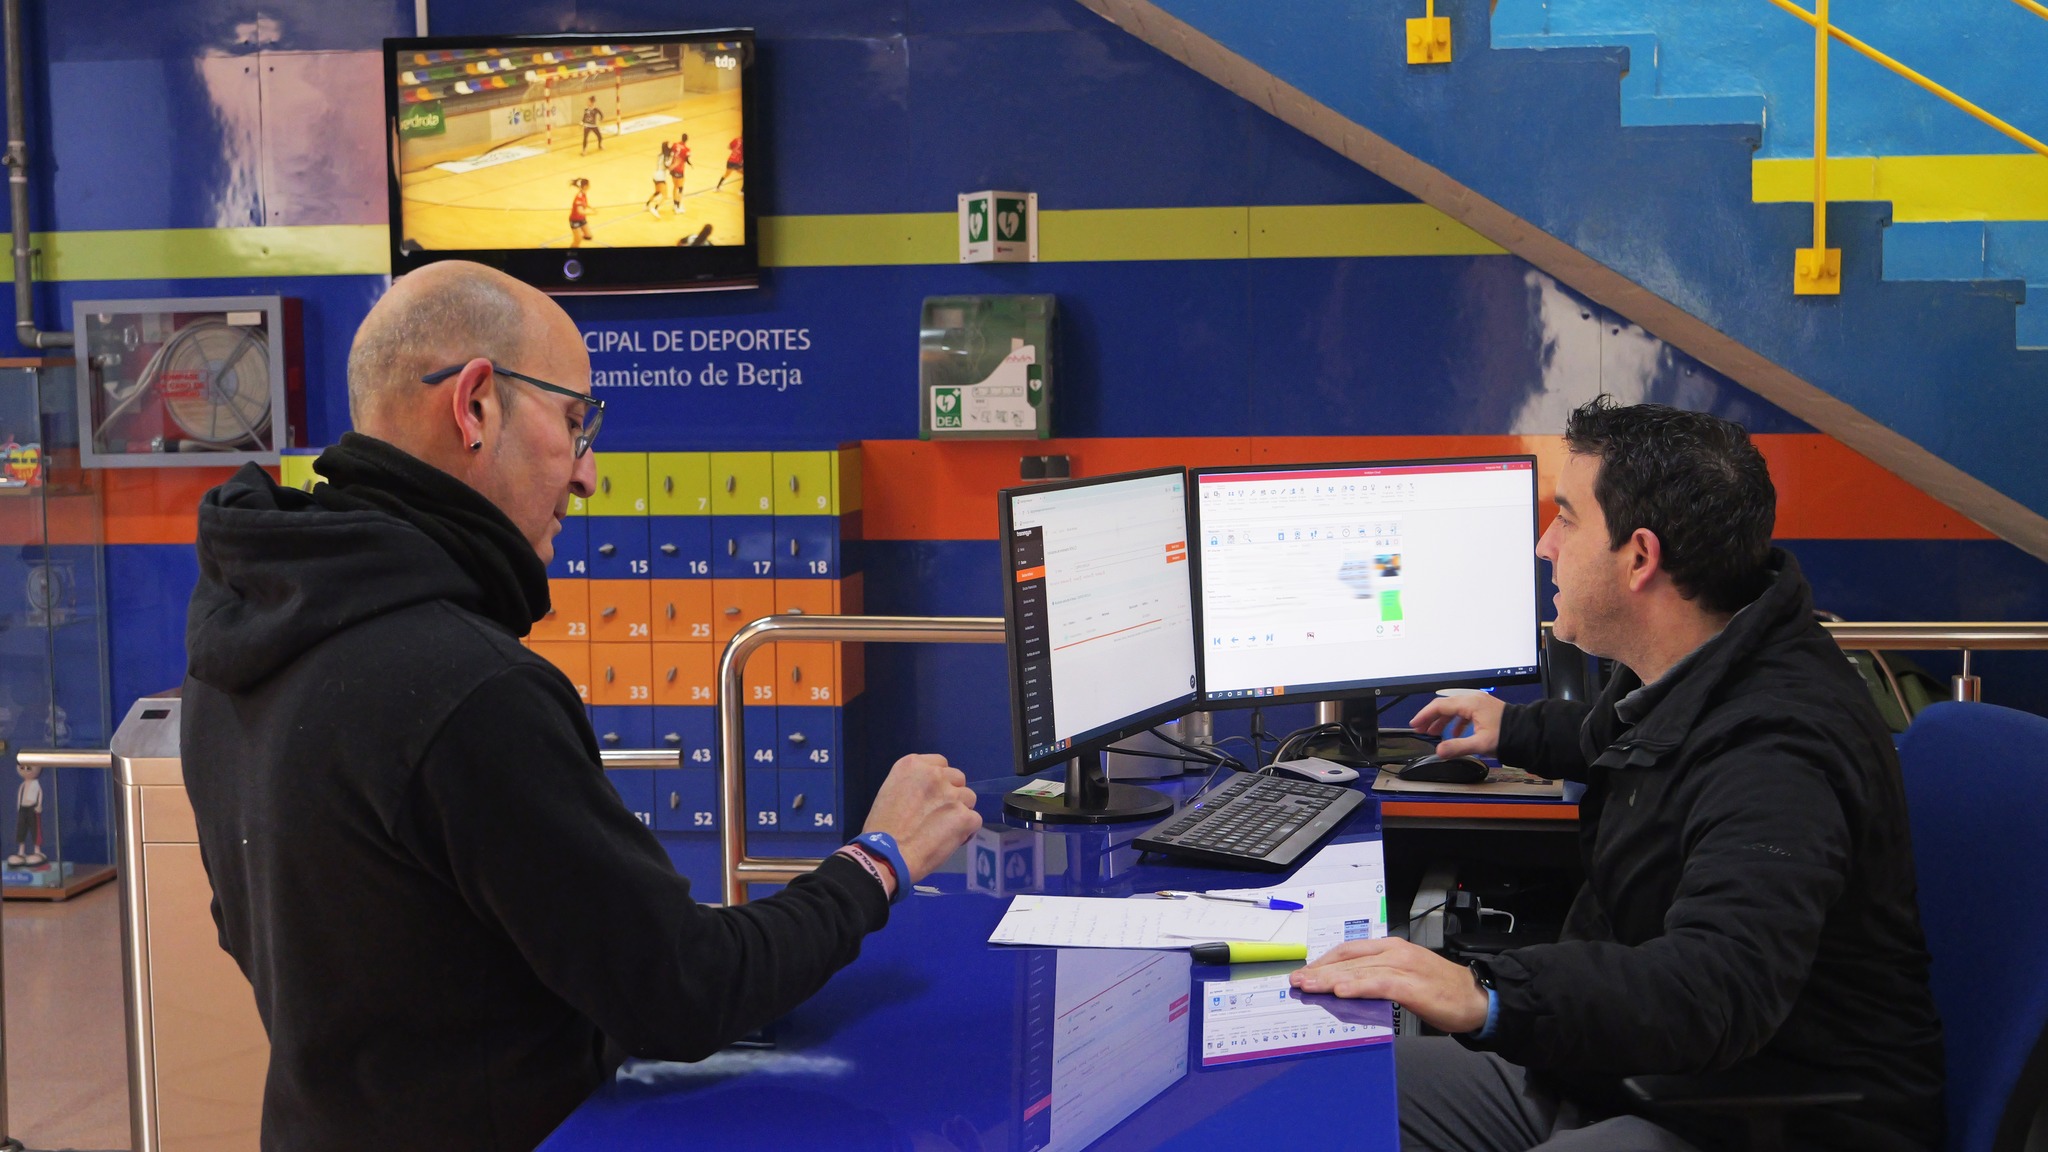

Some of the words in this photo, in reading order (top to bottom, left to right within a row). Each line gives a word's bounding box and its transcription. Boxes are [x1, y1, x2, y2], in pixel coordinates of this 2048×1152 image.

[714, 55, 737, 70] tdp
[583, 332, 646, 354] CIPAL
[654, 331, 683, 351] DE
[691, 329, 810, 351] DEPORTES
[700, 363, 727, 385] de
[738, 362, 801, 391] Berja
[936, 416, 961, 427] DEA
[574, 496, 583, 511] 5
[634, 498, 646, 512] 6
[698, 497, 707, 510] 7
[759, 496, 770, 510] 8
[816, 495, 827, 509] 9
[567, 560, 586, 574] 14
[630, 559, 649, 574] 15
[689, 560, 708, 575] 16
[753, 560, 771, 575] 17
[808, 560, 828, 574] 18
[568, 622, 586, 636] 23
[629, 623, 648, 637] 24
[691, 623, 711, 637] 25
[574, 684, 588, 699] 2
[630, 685, 649, 700] 33
[692, 686, 711, 700] 34
[754, 685, 773, 700] 35
[811, 686, 830, 700] 36
[691, 748, 712, 762] 43
[753, 749, 774, 763] 44
[809, 749, 829, 763] 45
[694, 811, 713, 826] 52
[758, 811, 778, 825] 53
[814, 812, 834, 827] 54
